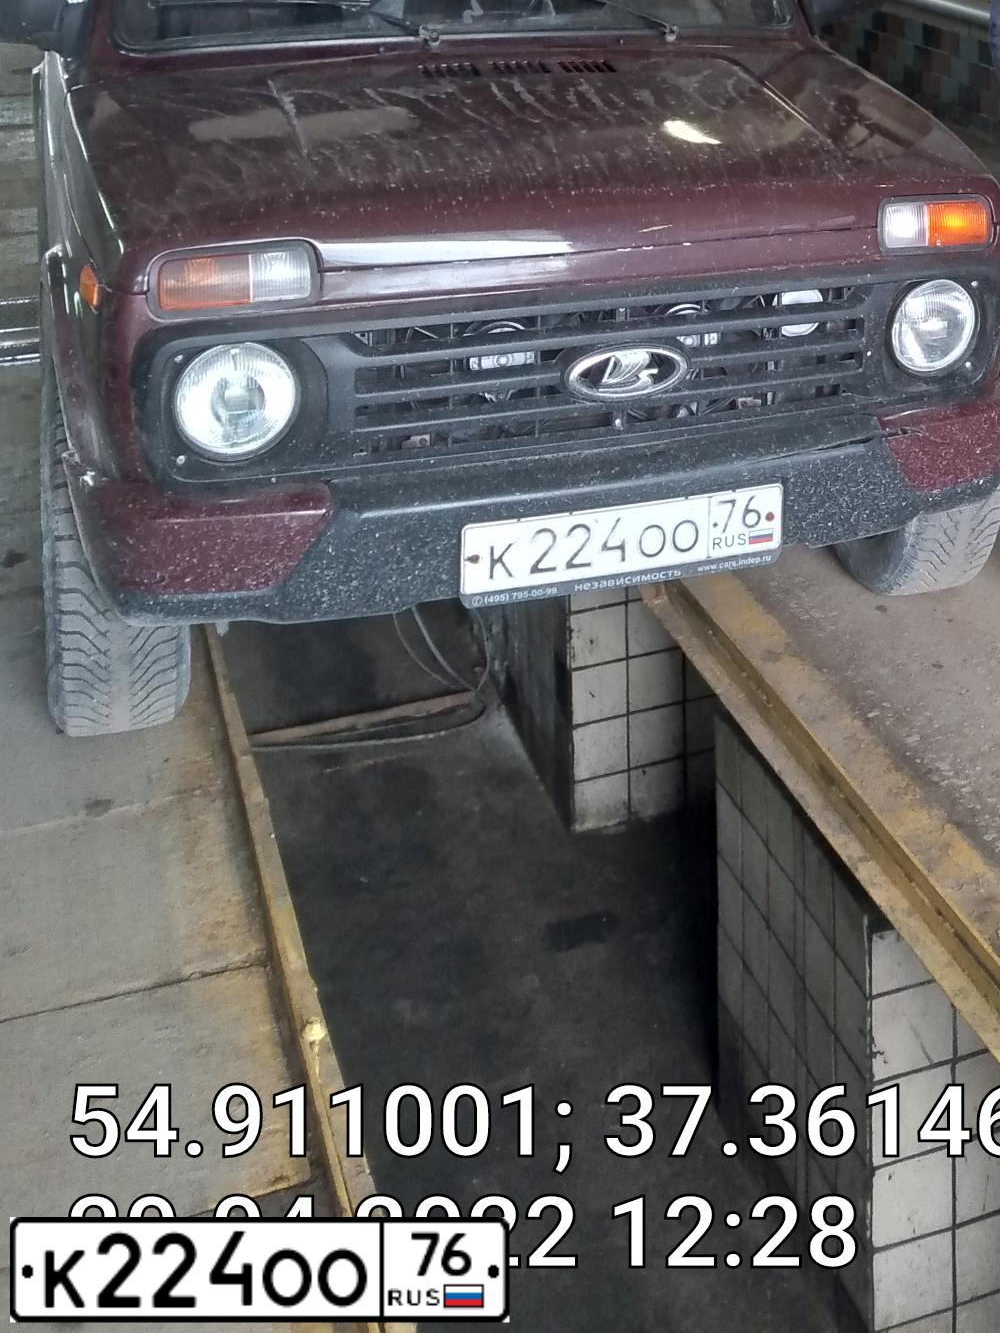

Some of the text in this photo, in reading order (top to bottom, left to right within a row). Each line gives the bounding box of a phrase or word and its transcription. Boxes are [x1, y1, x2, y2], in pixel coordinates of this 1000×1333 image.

[717, 495, 761, 533] 76
[712, 533, 747, 551] RUS
[574, 568, 682, 591] независимость
